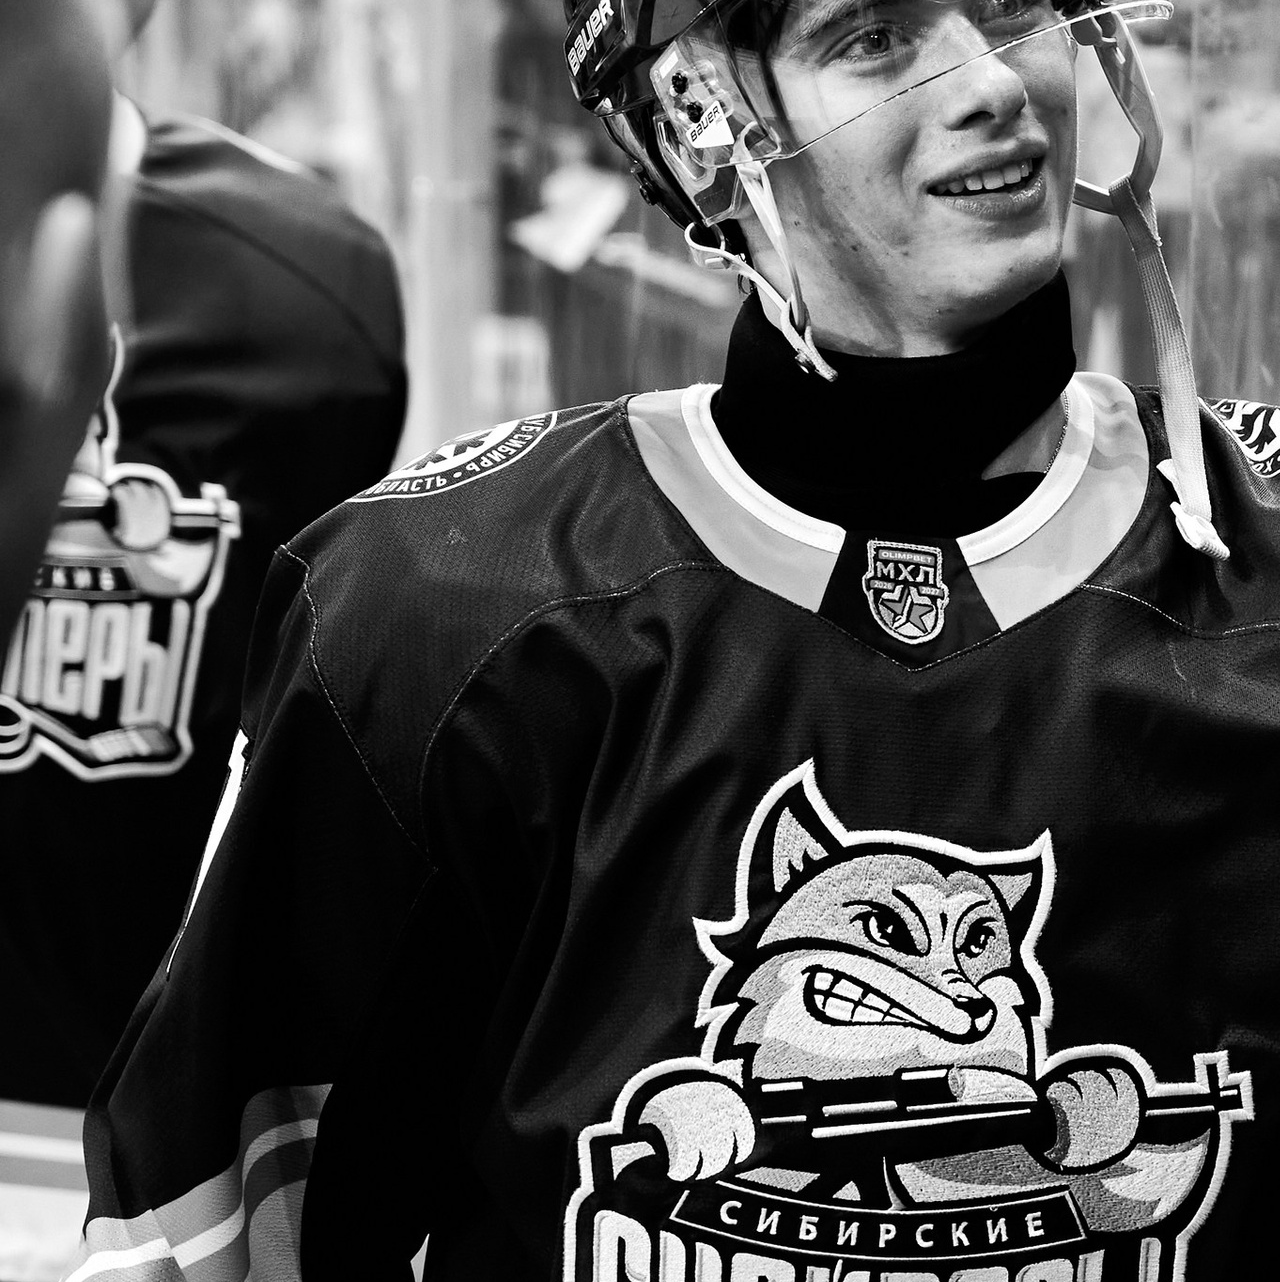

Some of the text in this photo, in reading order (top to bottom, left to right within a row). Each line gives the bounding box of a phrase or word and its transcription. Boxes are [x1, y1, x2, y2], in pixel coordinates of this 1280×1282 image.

[690, 105, 720, 142] BAUER
[881, 551, 932, 564] OLIMPBET
[876, 561, 935, 585] МХЛ
[719, 1199, 1047, 1249] СИБИРСКИЕ
